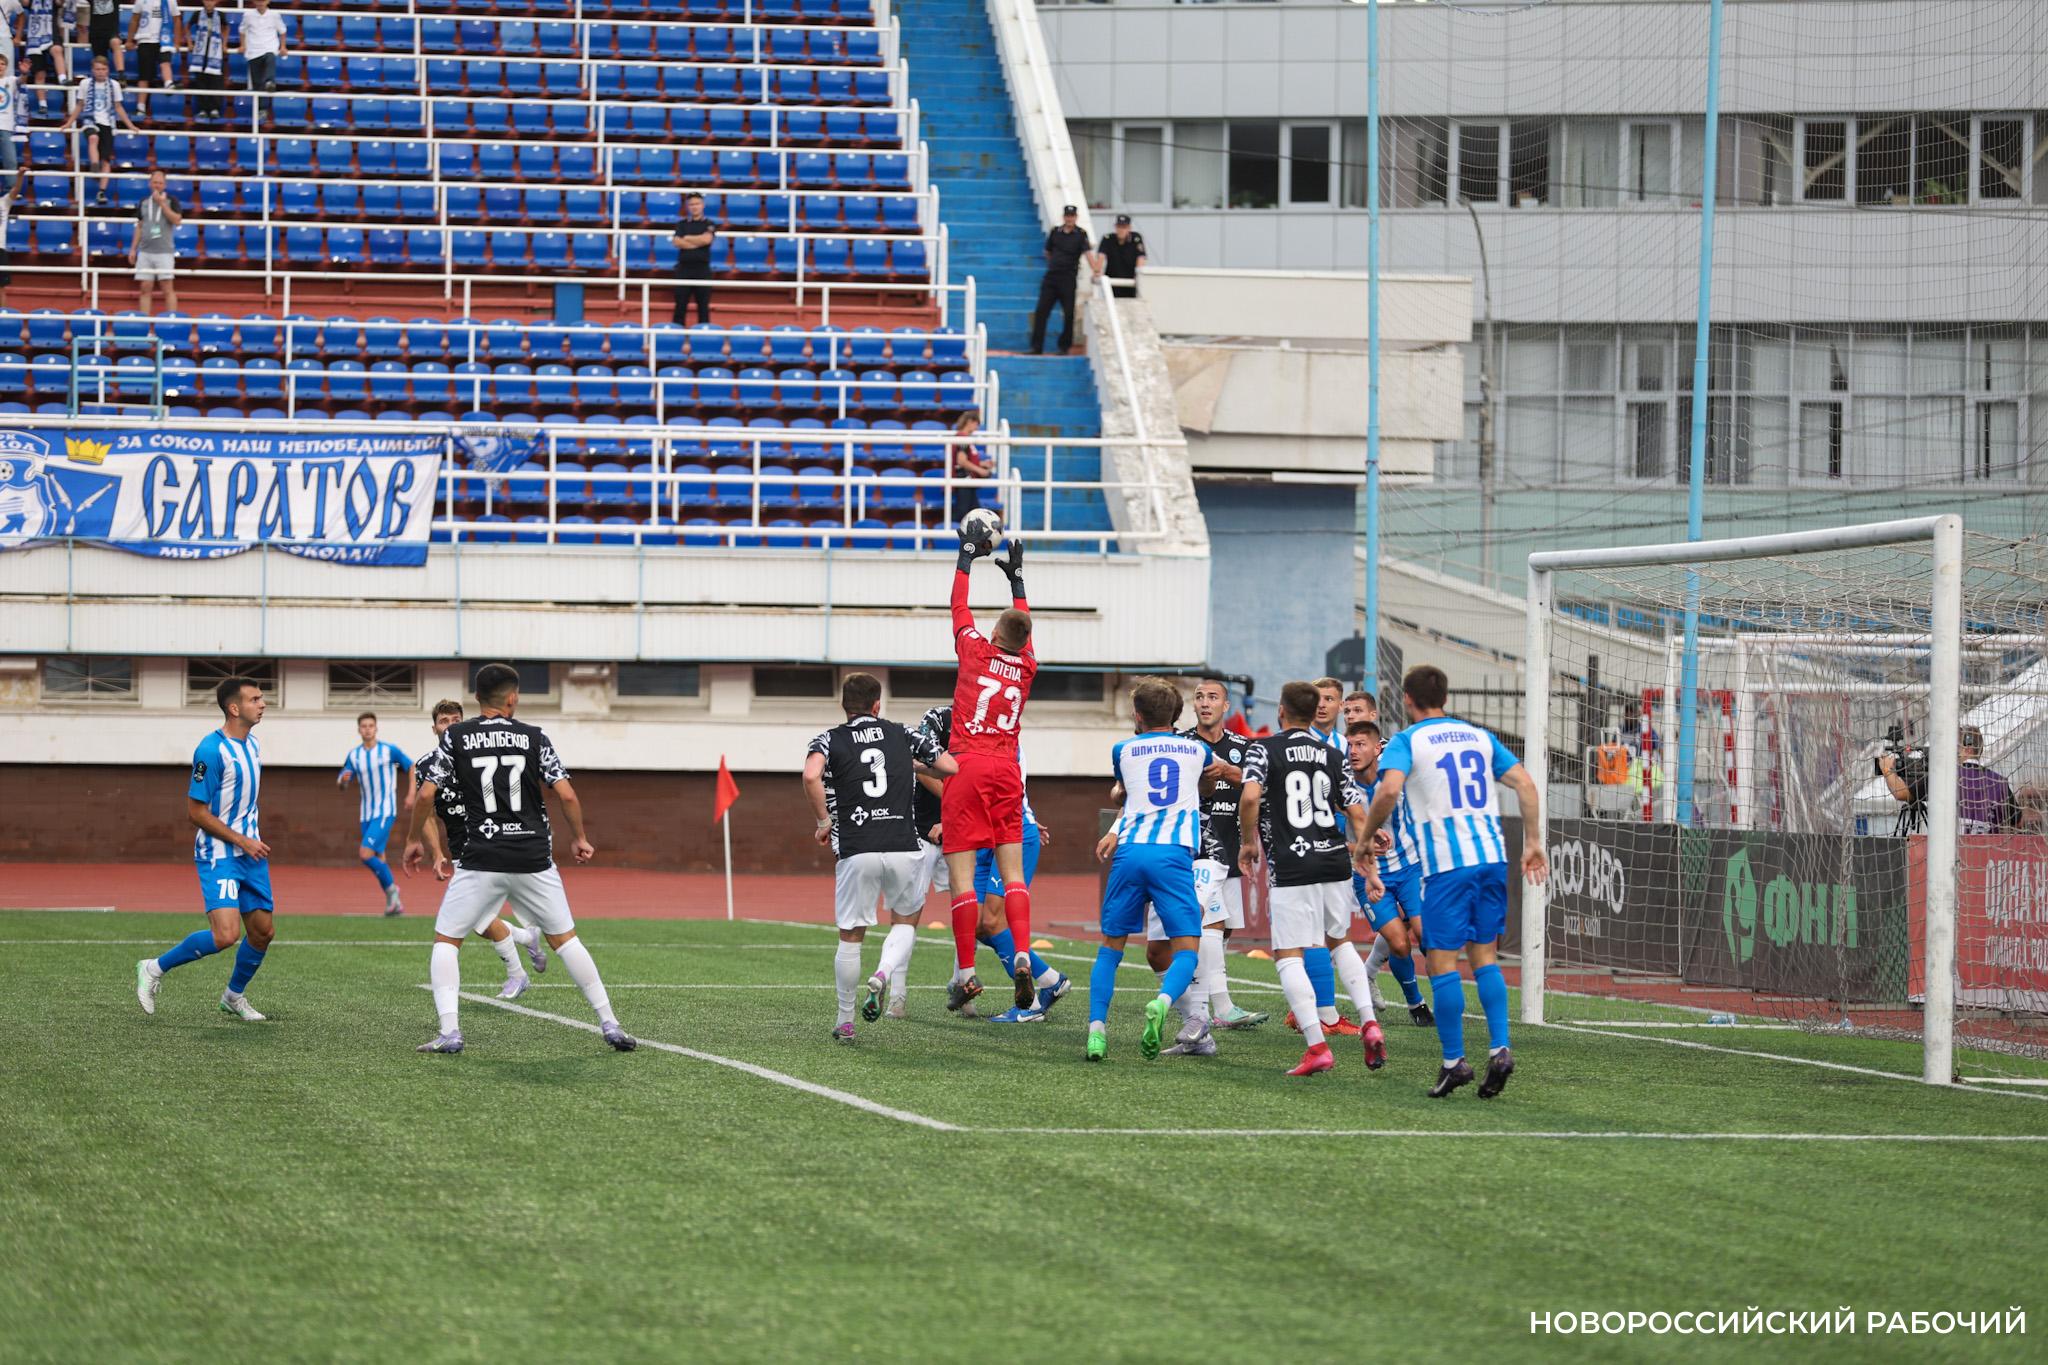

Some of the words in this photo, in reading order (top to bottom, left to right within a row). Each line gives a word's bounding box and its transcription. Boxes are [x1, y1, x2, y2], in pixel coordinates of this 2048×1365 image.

[117, 435, 143, 449] ЗА
[150, 434, 216, 452] СОКОЛ
[223, 439, 273, 453] НАШ
[142, 454, 415, 541] САРАТОВ
[160, 547, 201, 558] МЫ
[989, 658, 1021, 682] ШТЕПА
[976, 675, 1022, 730] 73
[462, 730, 530, 750] ЗАРЫПБЕКОВ
[851, 727, 885, 744] ПЛИЕВ
[1131, 743, 1198, 757] ШПИТАЛЬНЫЙ
[1285, 745, 1328, 766] СТОЦКИЙ
[471, 755, 526, 813] 77
[860, 748, 888, 798] 3
[1147, 757, 1180, 807] 9
[1435, 750, 1487, 809] 13
[1285, 769, 1336, 829] 89
[871, 808, 890, 816] КСК
[502, 823, 522, 831] КСК
[1589, 841, 1624, 914] BRO
[217, 879, 239, 900] 70
